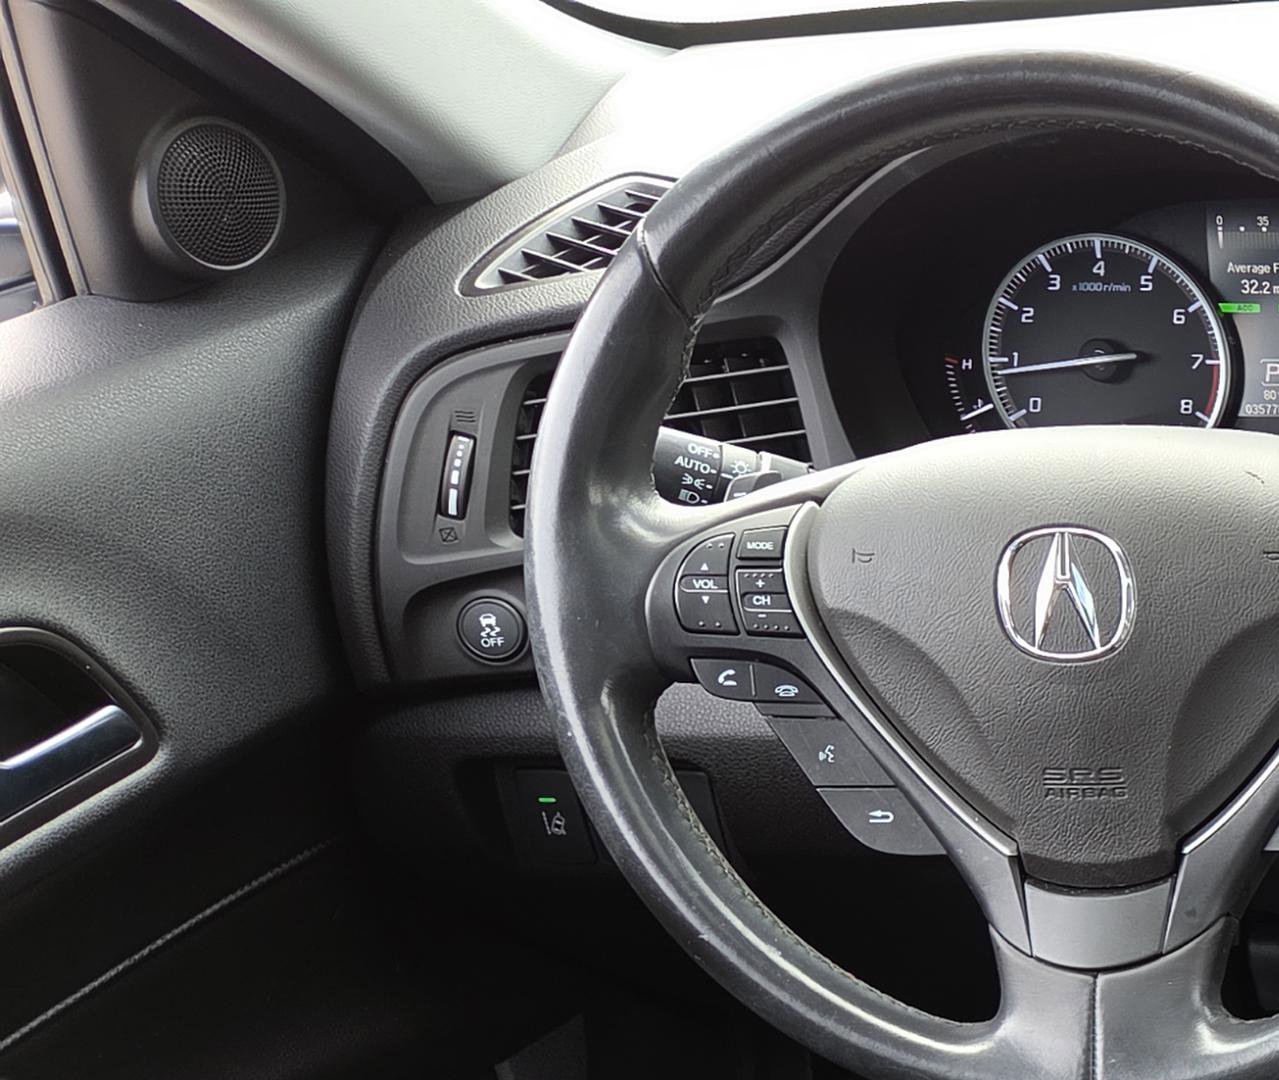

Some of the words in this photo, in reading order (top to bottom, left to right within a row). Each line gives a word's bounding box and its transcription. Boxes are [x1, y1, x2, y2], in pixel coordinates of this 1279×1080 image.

[1215, 215, 1224, 226] 0
[1256, 216, 1270, 226] 35
[1092, 260, 1106, 277] 4
[1227, 262, 1271, 276] Average
[1047, 275, 1062, 291] 3
[1139, 276, 1153, 291] 5
[1240, 279, 1271, 295] 32.2
[1020, 307, 1035, 323] 2
[1172, 309, 1186, 324] 6
[961, 358, 973, 371] H
[1012, 351, 1019, 367] 1
[1190, 354, 1204, 370] 7
[1263, 389, 1278, 401] 80
[1029, 397, 1042, 413] 0
[1179, 399, 1193, 415] 8
[687, 443, 713, 459] OFF
[673, 455, 712, 475] AUTO
[746, 541, 774, 551] MODE
[692, 579, 719, 590] VOL
[752, 595, 772, 606] CH
[480, 637, 504, 649] OFF
[1044, 786, 1129, 801] AIRBAG
